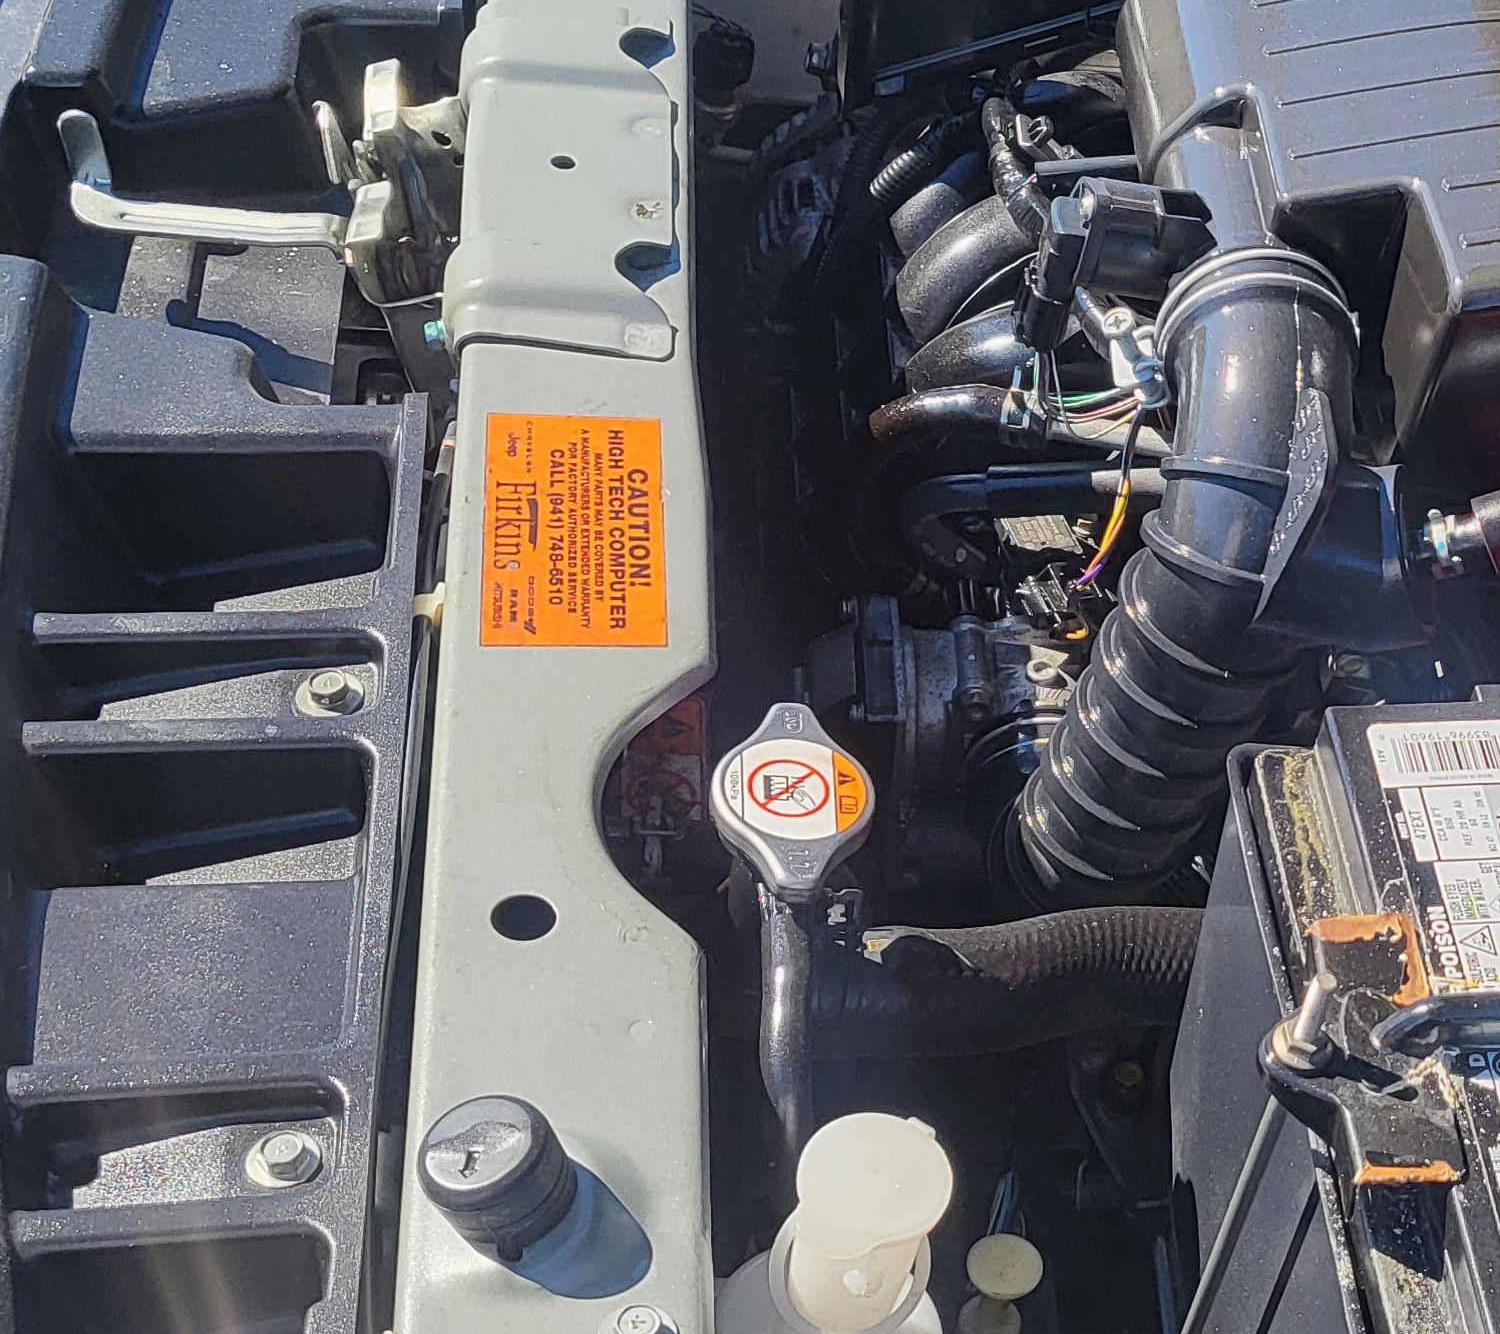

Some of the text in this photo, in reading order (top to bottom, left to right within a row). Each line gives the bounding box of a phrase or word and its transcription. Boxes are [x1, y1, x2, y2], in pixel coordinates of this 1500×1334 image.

[506, 433, 519, 457] Jeep
[580, 437, 589, 511] MANUFACTURERS
[494, 480, 537, 570] Firkins
[546, 449, 564, 605] CALL (941) 748-6510
[568, 443, 577, 614] FOR FACTORY AUTHORIZED SERVICE
[581, 513, 589, 526] OR
[581, 529, 590, 575] EXTENDED
[594, 453, 604, 602] MANY PARTS MAY BE COVERED BY
[608, 429, 626, 629] HIGH TECH COMPUTER
[628, 468, 652, 587] CAUTION!
[510, 589, 518, 623] RAM
[581, 578, 590, 629] WARRANTY
[1407, 809, 1429, 840] 47EXT
